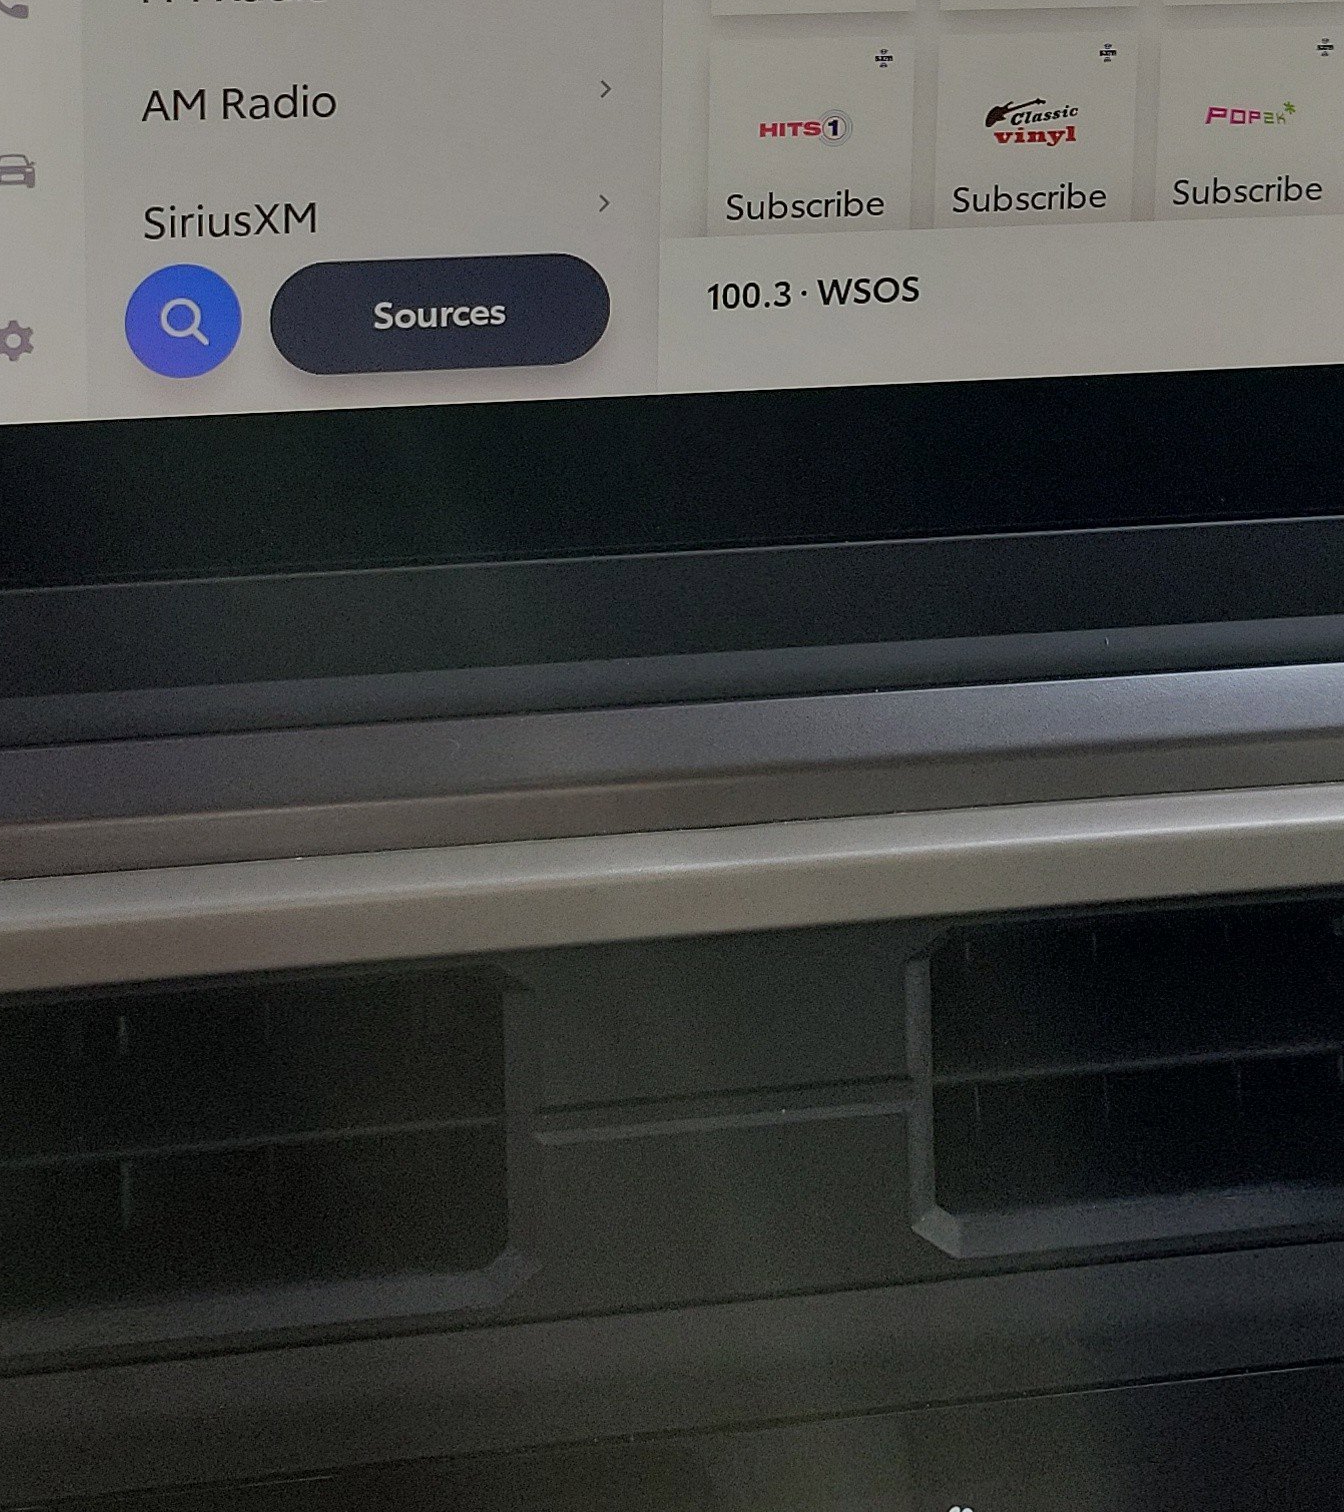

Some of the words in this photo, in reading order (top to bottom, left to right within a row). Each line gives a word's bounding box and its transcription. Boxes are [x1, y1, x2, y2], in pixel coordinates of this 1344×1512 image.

[142, 89, 205, 121] AM
[223, 84, 336, 119] Radio
[1009, 104, 1079, 127] Classic
[760, 121, 820, 137] HITS
[994, 125, 1077, 146] vinyl
[727, 189, 884, 220] Subscribe
[953, 182, 1106, 212] Subscribe
[1173, 175, 1322, 205] Subscribe
[145, 203, 315, 239] SiriusXM
[708, 282, 791, 310] 100.3
[818, 277, 919, 305] WSOS
[374, 302, 505, 329] Sources
